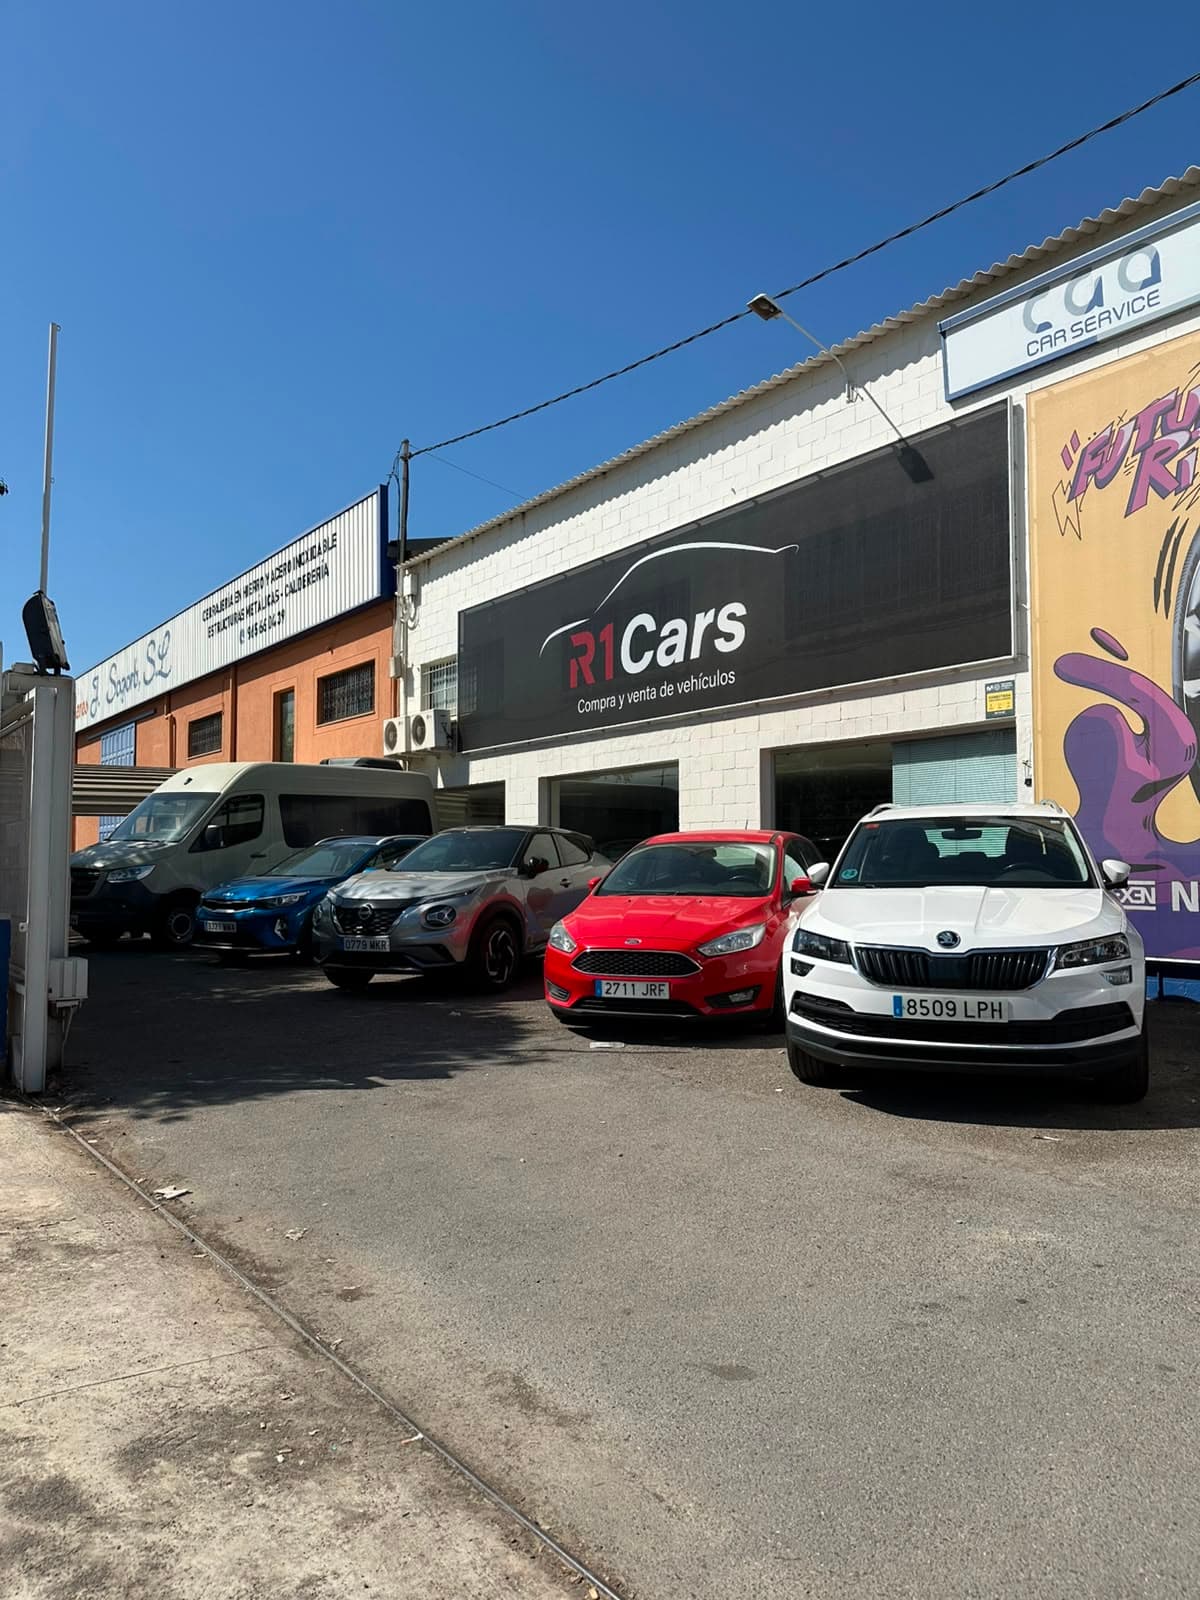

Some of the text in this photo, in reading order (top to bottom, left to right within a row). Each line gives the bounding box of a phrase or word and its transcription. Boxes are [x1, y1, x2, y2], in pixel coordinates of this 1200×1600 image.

[1026, 289, 1161, 357] CAR SERVICE
[271, 560, 292, 584] ACERO
[293, 532, 337, 571] INOXIDABLE
[577, 669, 736, 713] Compra y venta de vehículos
[345, 939, 368, 950] 0779
[604, 982, 666, 997] 2711 JRF
[906, 998, 1003, 1019] 8509 LPH
